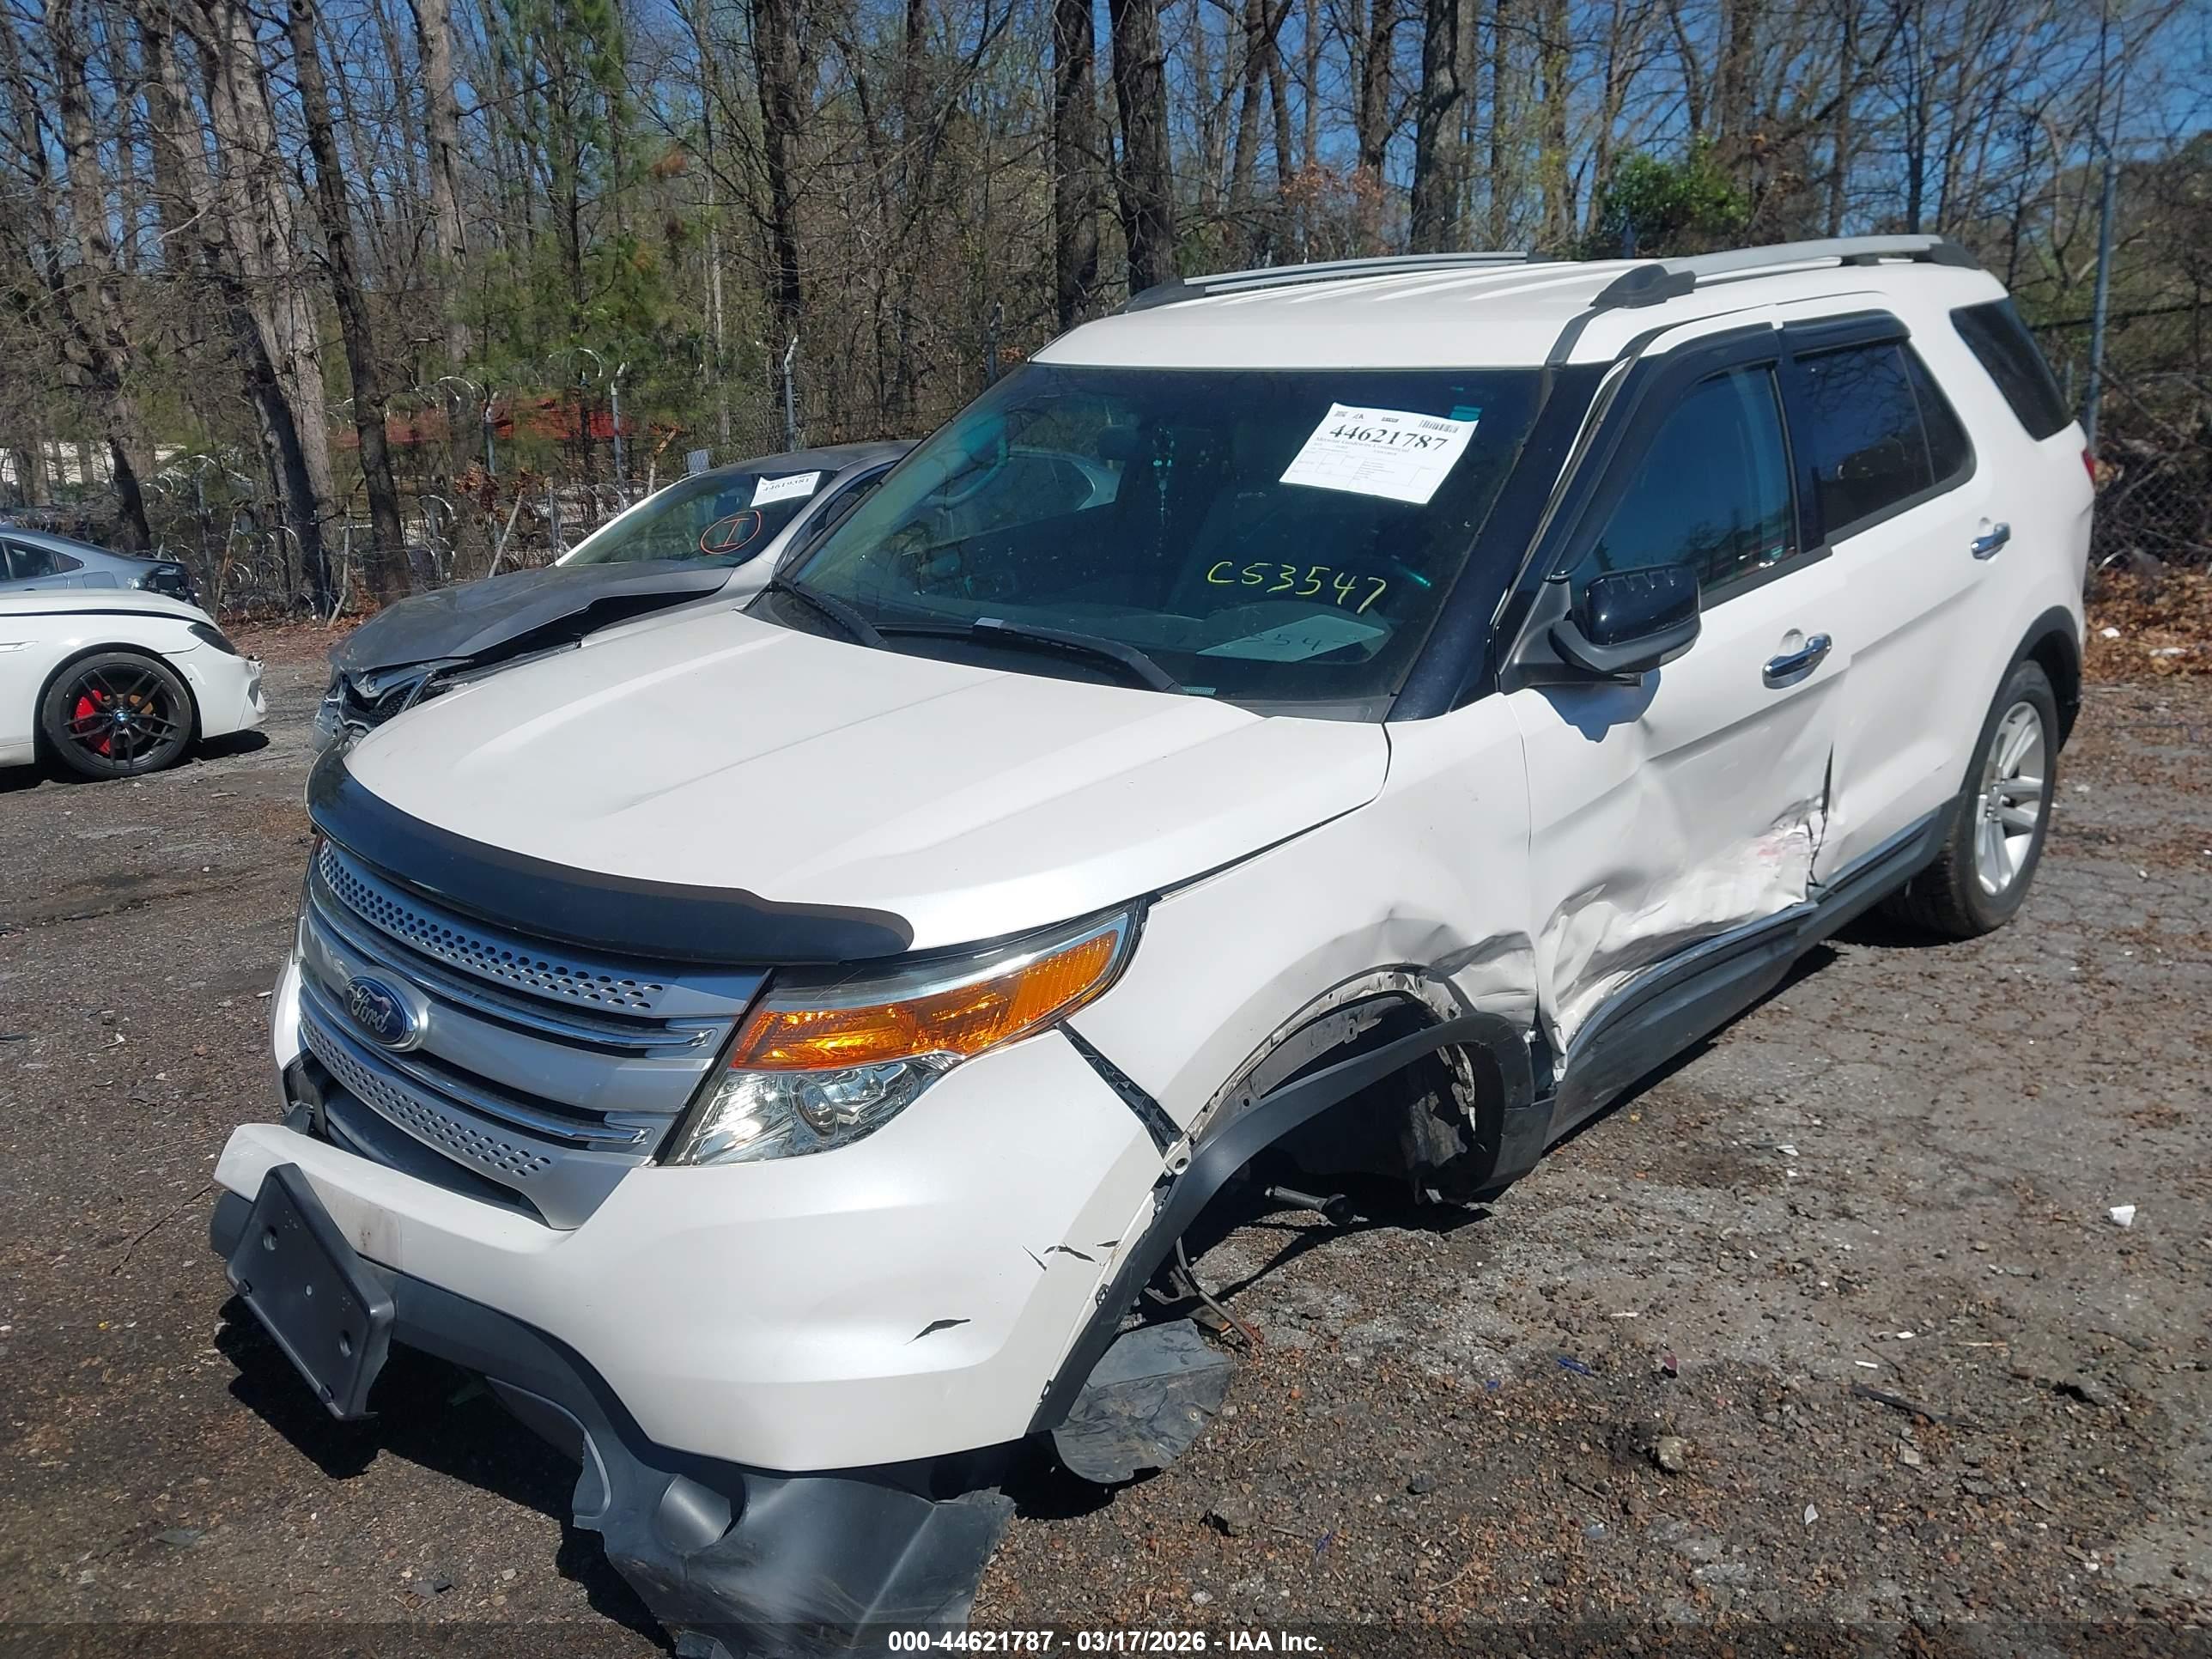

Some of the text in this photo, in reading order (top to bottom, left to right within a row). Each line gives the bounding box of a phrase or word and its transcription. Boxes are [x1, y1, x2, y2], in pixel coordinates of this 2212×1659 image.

[1329, 423, 1449, 452] 44621787
[1207, 561, 1387, 615] C53547
[347, 983, 392, 1034] Ford
